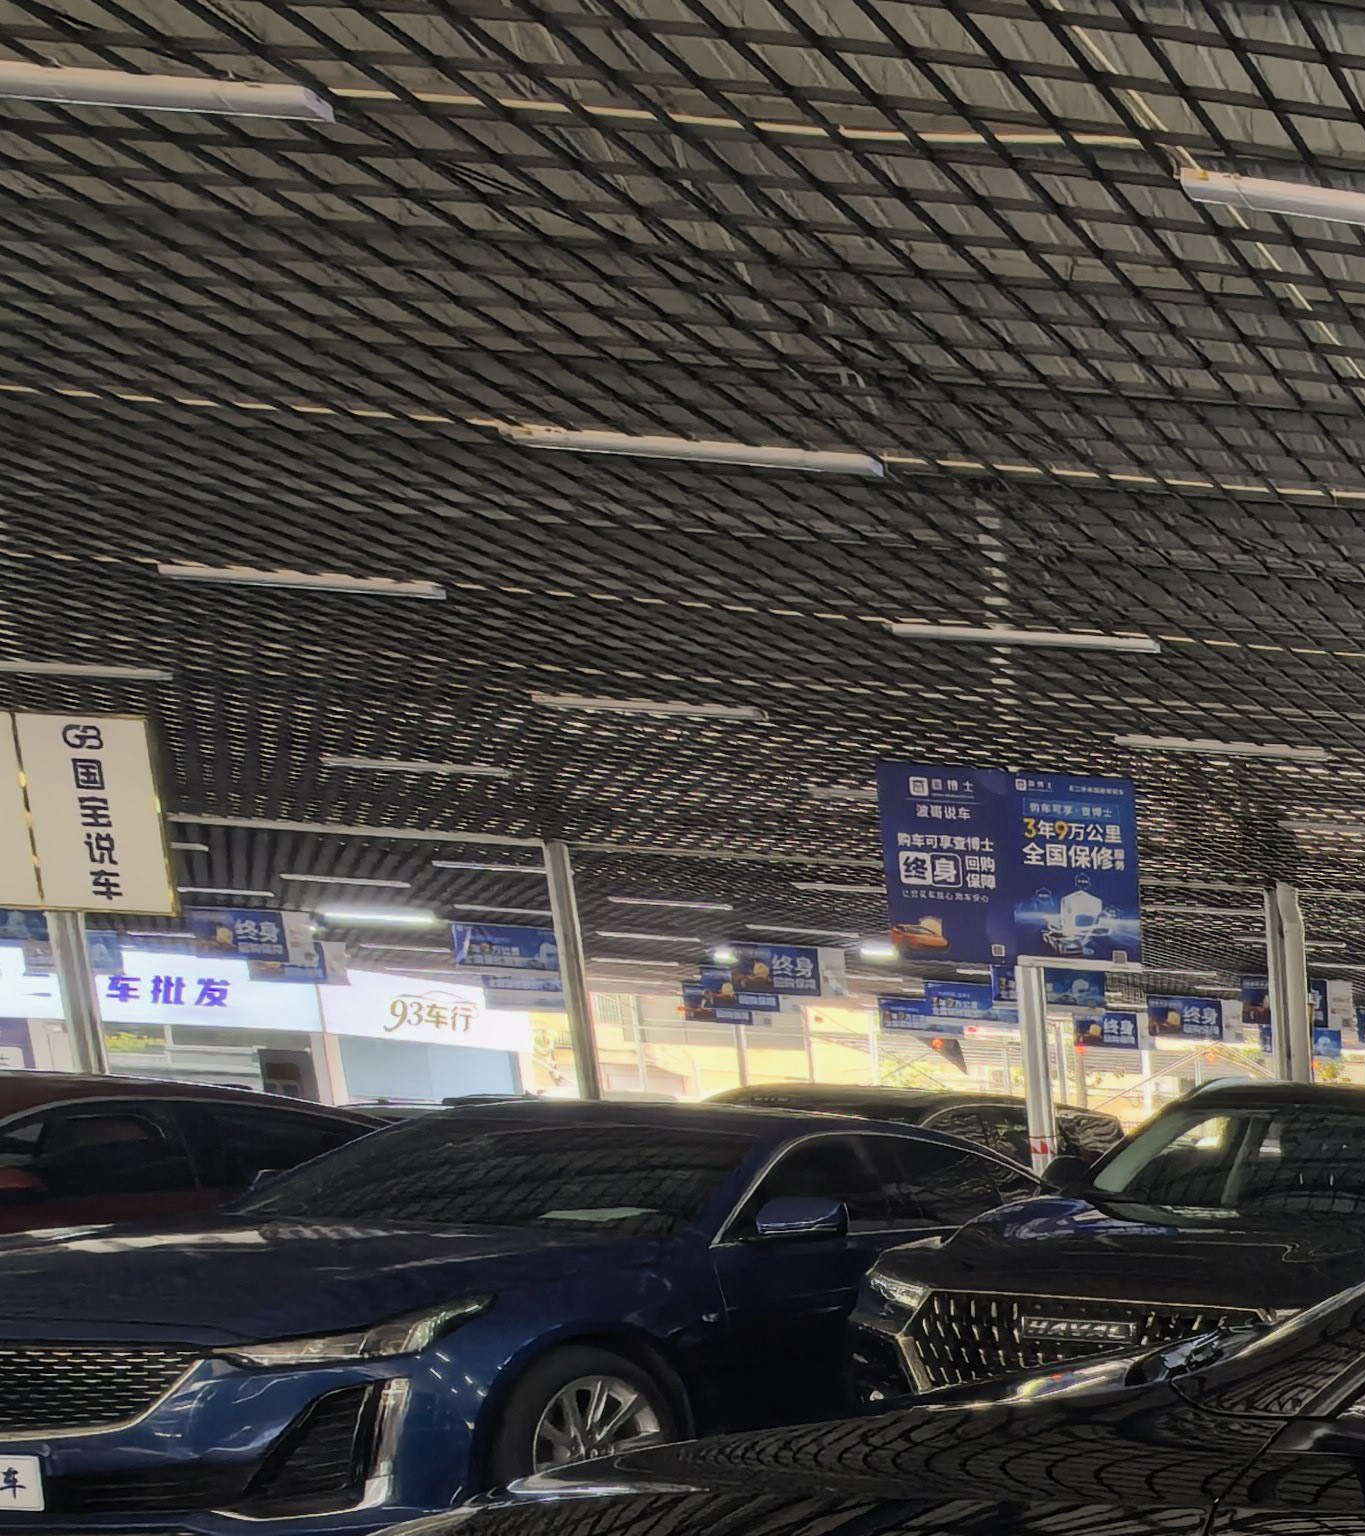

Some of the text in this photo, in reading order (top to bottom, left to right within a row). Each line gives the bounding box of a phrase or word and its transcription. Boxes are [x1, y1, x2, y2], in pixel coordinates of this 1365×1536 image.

[915, 803, 972, 821] 波哥说车
[71, 757, 124, 901] 国宝说车
[1023, 817, 1122, 844] 3年9万公里
[896, 832, 995, 853] 购车可享查博士
[900, 852, 962, 887] 终身
[235, 918, 280, 943] 终身
[771, 954, 814, 978] 终身
[384, 1000, 474, 1032] 93车行
[1103, 1018, 1135, 1036] 终身
[1183, 1006, 1218, 1025] 终身
